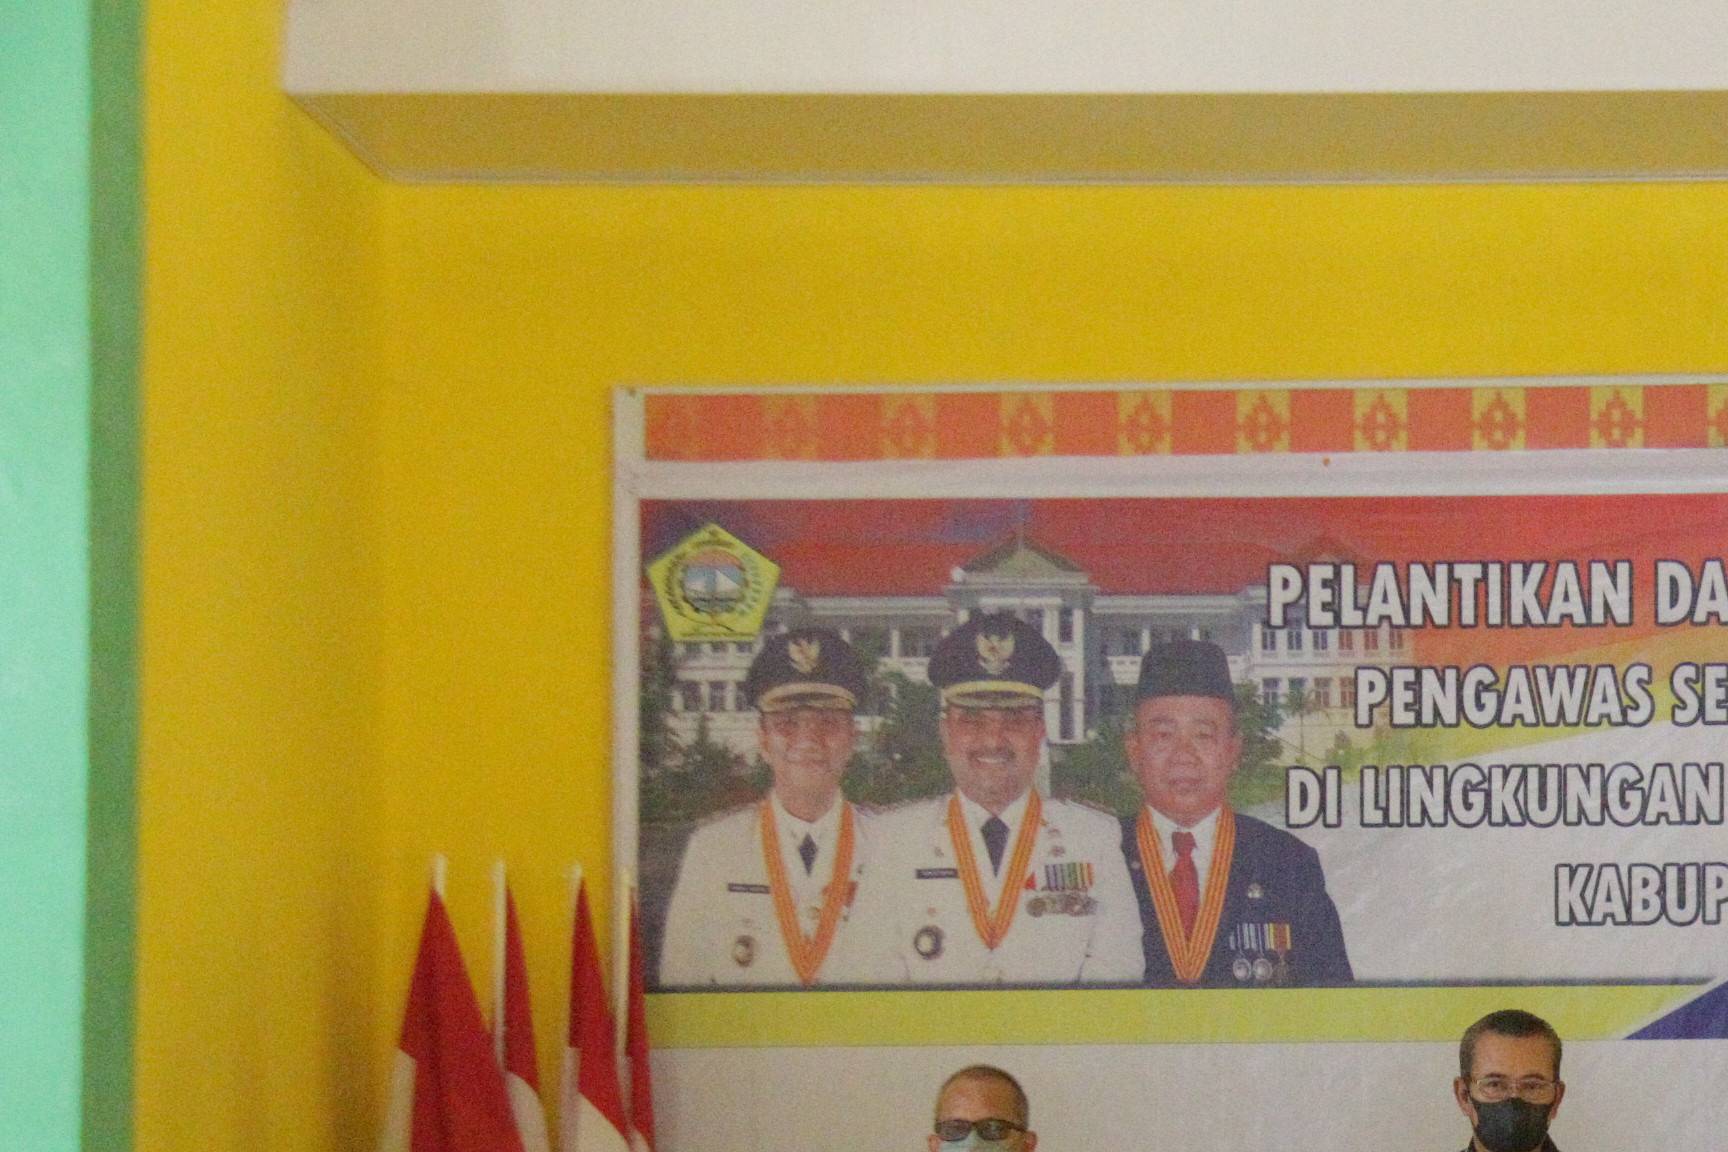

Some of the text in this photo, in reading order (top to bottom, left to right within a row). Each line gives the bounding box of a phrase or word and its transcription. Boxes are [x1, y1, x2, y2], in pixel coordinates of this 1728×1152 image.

[1267, 557, 1633, 630] PELANTIKAN
[1353, 662, 1653, 728] PENGAWAS
[1285, 765, 1342, 828] DI
[1359, 760, 1724, 829] LINGKUNGAN
